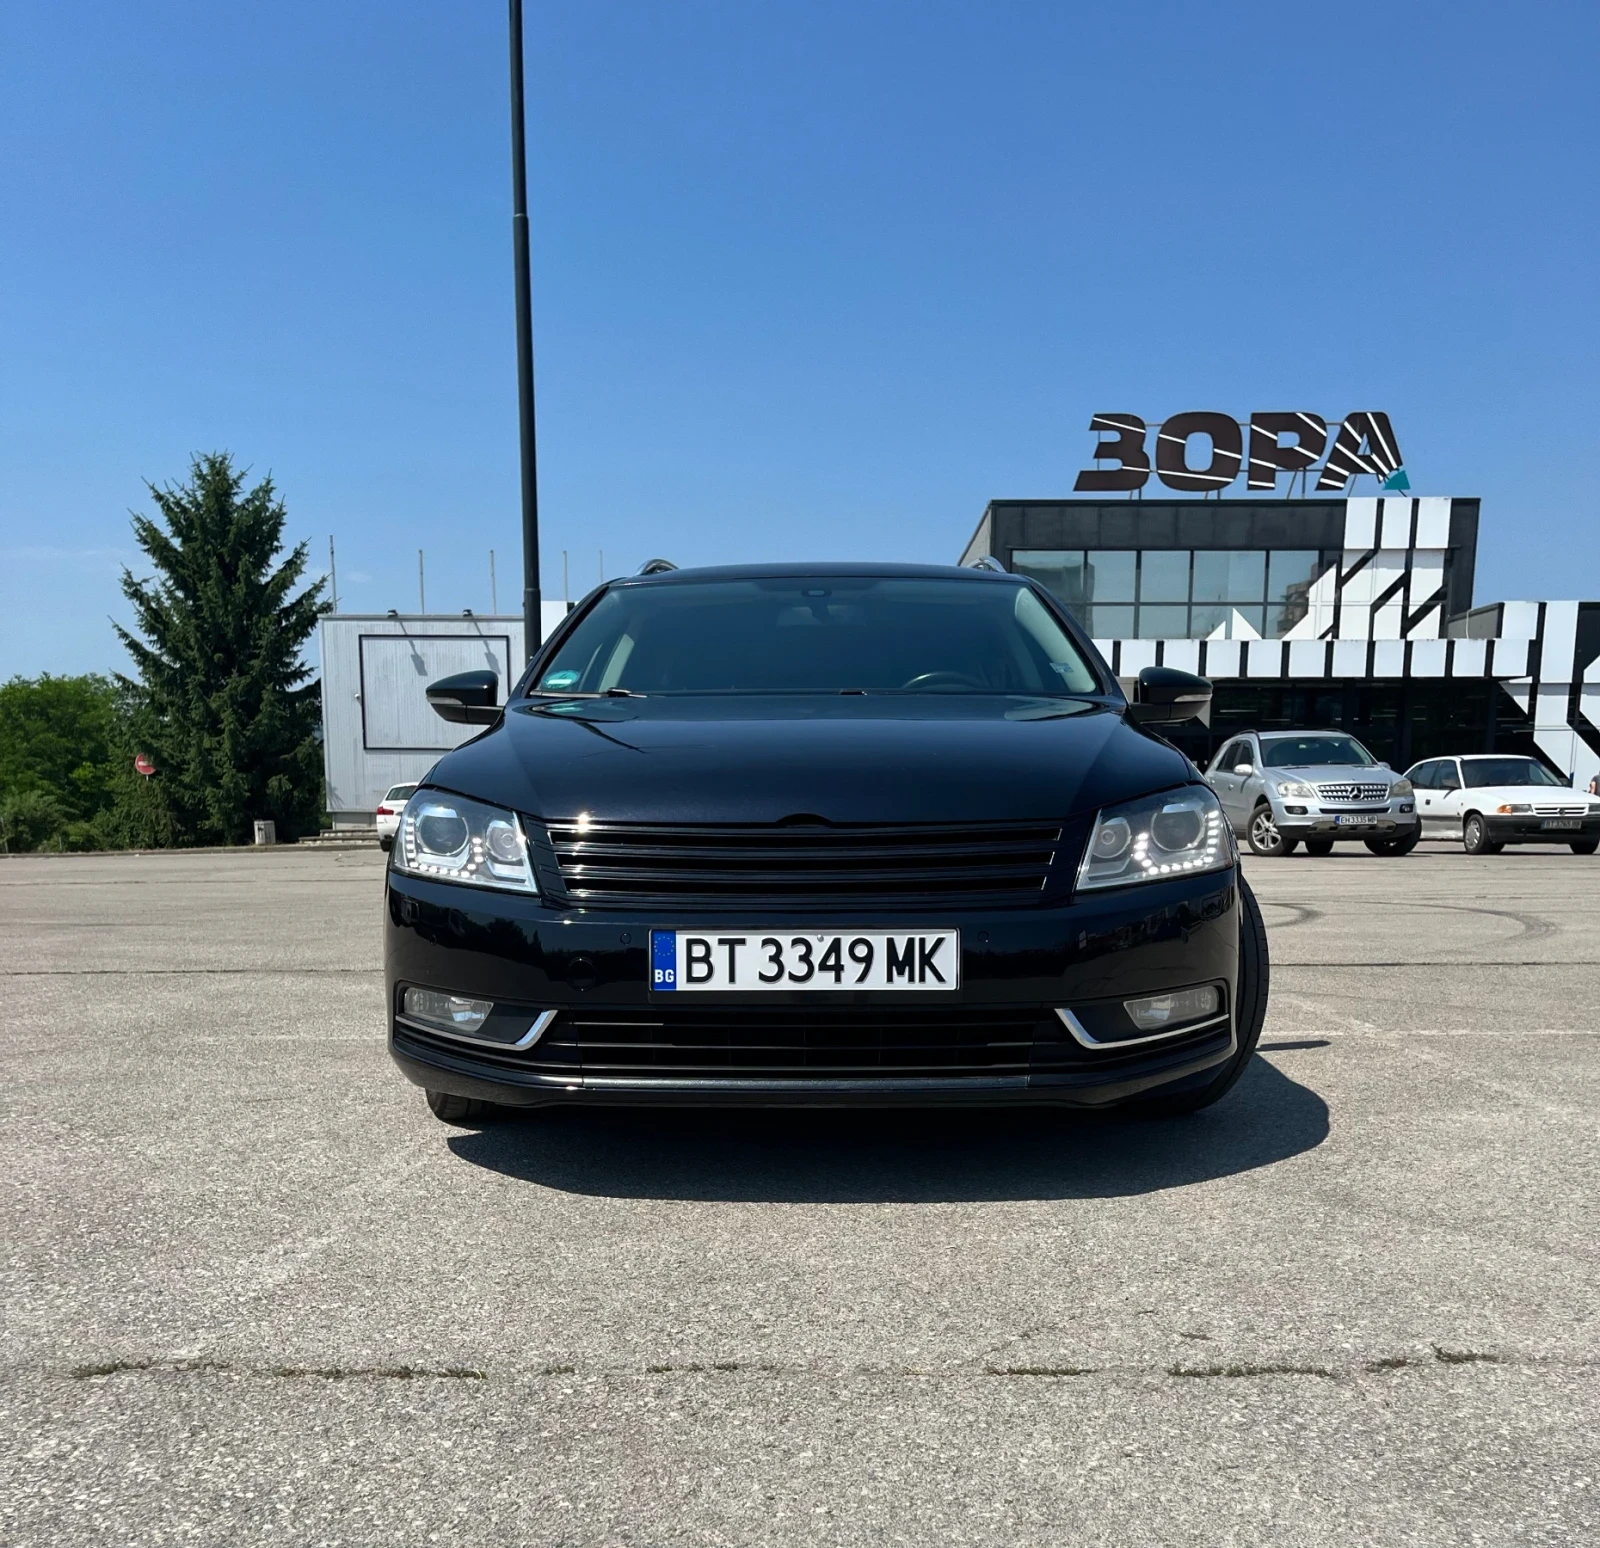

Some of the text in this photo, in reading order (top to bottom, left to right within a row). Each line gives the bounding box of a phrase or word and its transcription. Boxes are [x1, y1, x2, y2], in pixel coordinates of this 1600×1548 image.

[1073, 411, 1403, 491] ЗОРА
[654, 969, 674, 983] BG
[685, 937, 946, 983] BT 3349 MK
